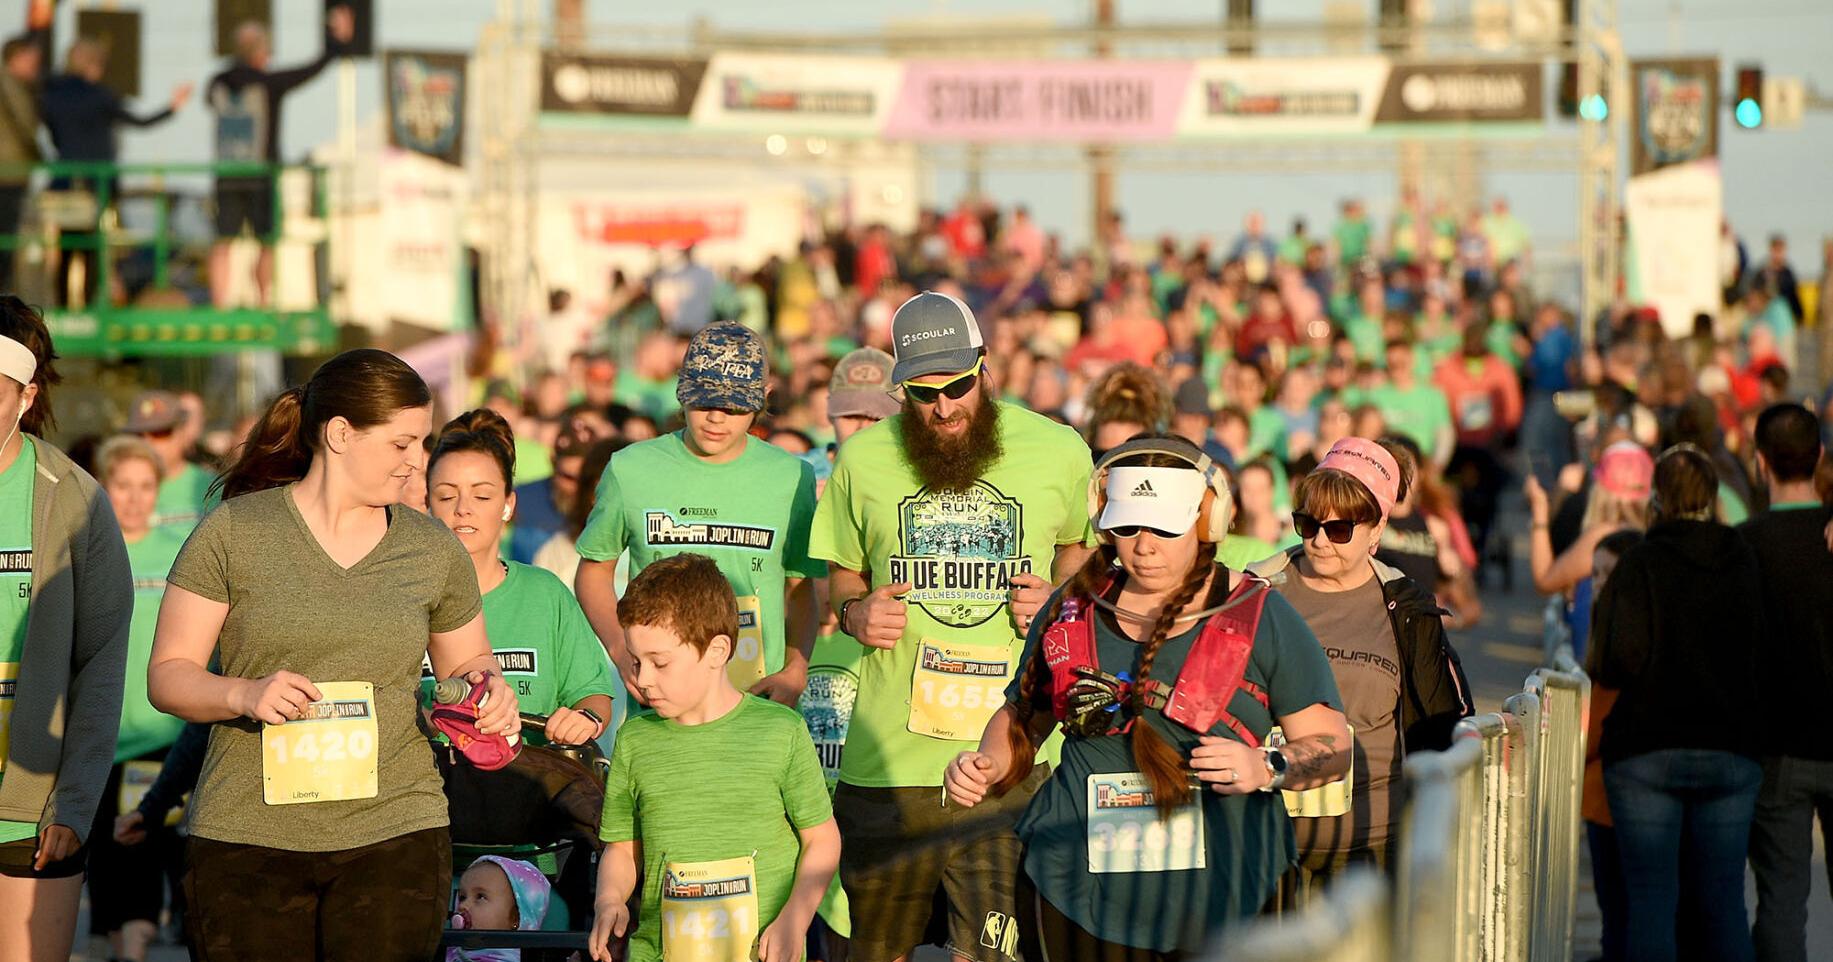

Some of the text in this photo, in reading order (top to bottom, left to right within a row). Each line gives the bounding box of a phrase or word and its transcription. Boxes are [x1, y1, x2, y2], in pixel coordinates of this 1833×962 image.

[928, 76, 1023, 121] START
[1039, 77, 1153, 121] FINISH
[912, 327, 956, 341] SCOULAR
[722, 362, 751, 379] FFA
[931, 495, 990, 503] MEMORIAL
[688, 507, 719, 516] FREEMAN
[942, 502, 978, 513] RUN
[709, 527, 745, 544] JOPLIN
[751, 529, 770, 547] RUN
[752, 557, 764, 572] 5K
[890, 560, 939, 590] BLUE
[912, 591, 961, 600] WELLNESS
[511, 654, 531, 669] RUN
[963, 663, 988, 674] JOPLIN
[991, 665, 1004, 675] RUN
[1323, 647, 1399, 677] QUARED
[518, 680, 531, 695] 5K
[920, 680, 1002, 709] 1655
[348, 703, 365, 716] RUN
[932, 726, 954, 737] Liberty
[270, 730, 372, 764] 1420
[292, 791, 320, 799] Liberty
[703, 881, 729, 896] JOPLIN
[733, 879, 747, 893] RUN
[665, 906, 749, 941] 1421
